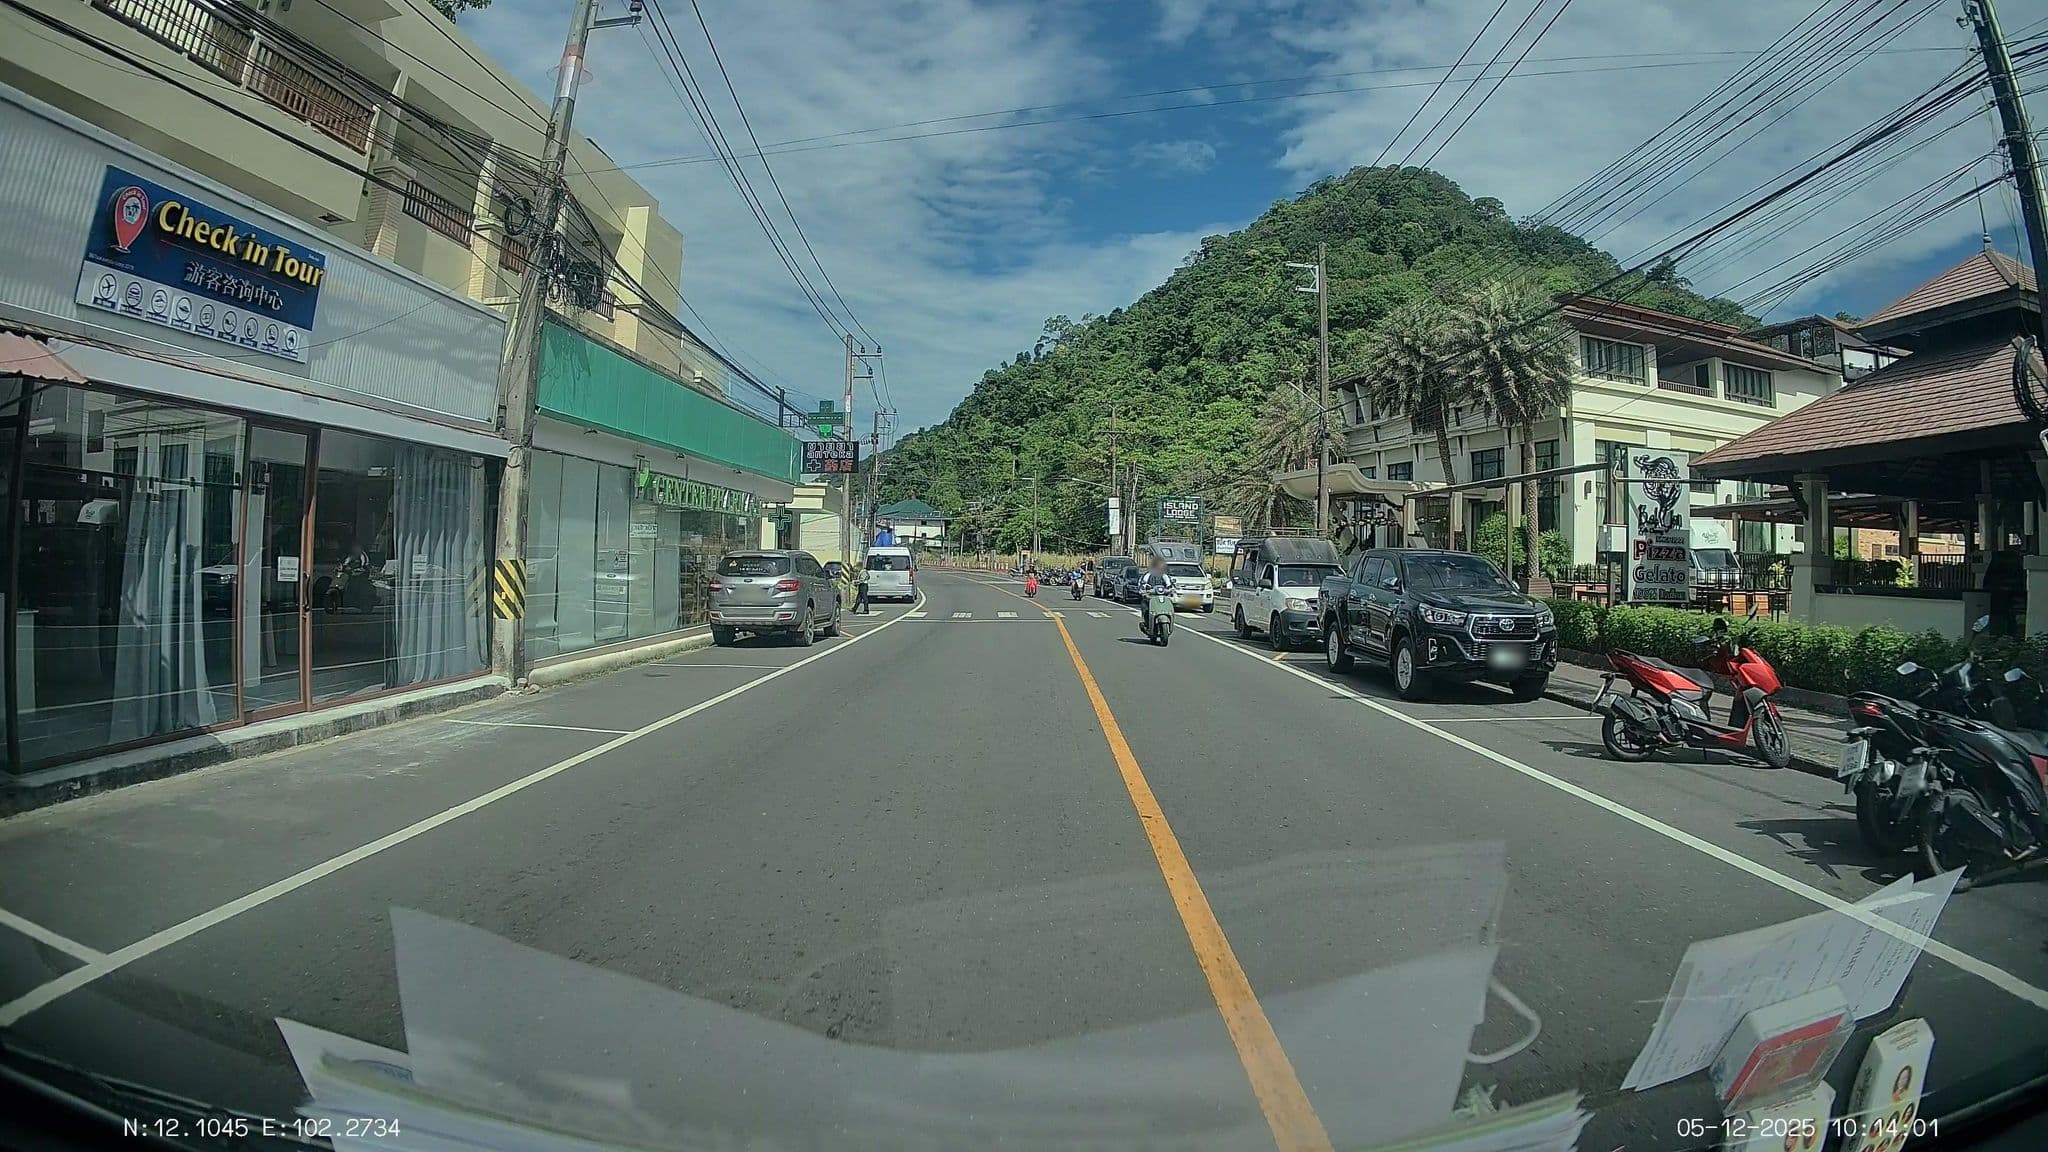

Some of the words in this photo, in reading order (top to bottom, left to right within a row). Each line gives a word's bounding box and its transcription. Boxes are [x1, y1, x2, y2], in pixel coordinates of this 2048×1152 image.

[159, 201, 241, 256] Check
[244, 233, 269, 267] in
[273, 245, 324, 287] Tour
[184, 261, 284, 311] 游客咨询中心
[655, 475, 708, 511] CENTER
[1163, 502, 1199, 510] ISLAND
[1166, 509, 1196, 517] LODGE
[1633, 538, 1687, 561] Pizza
[1632, 564, 1686, 584] Gelato
